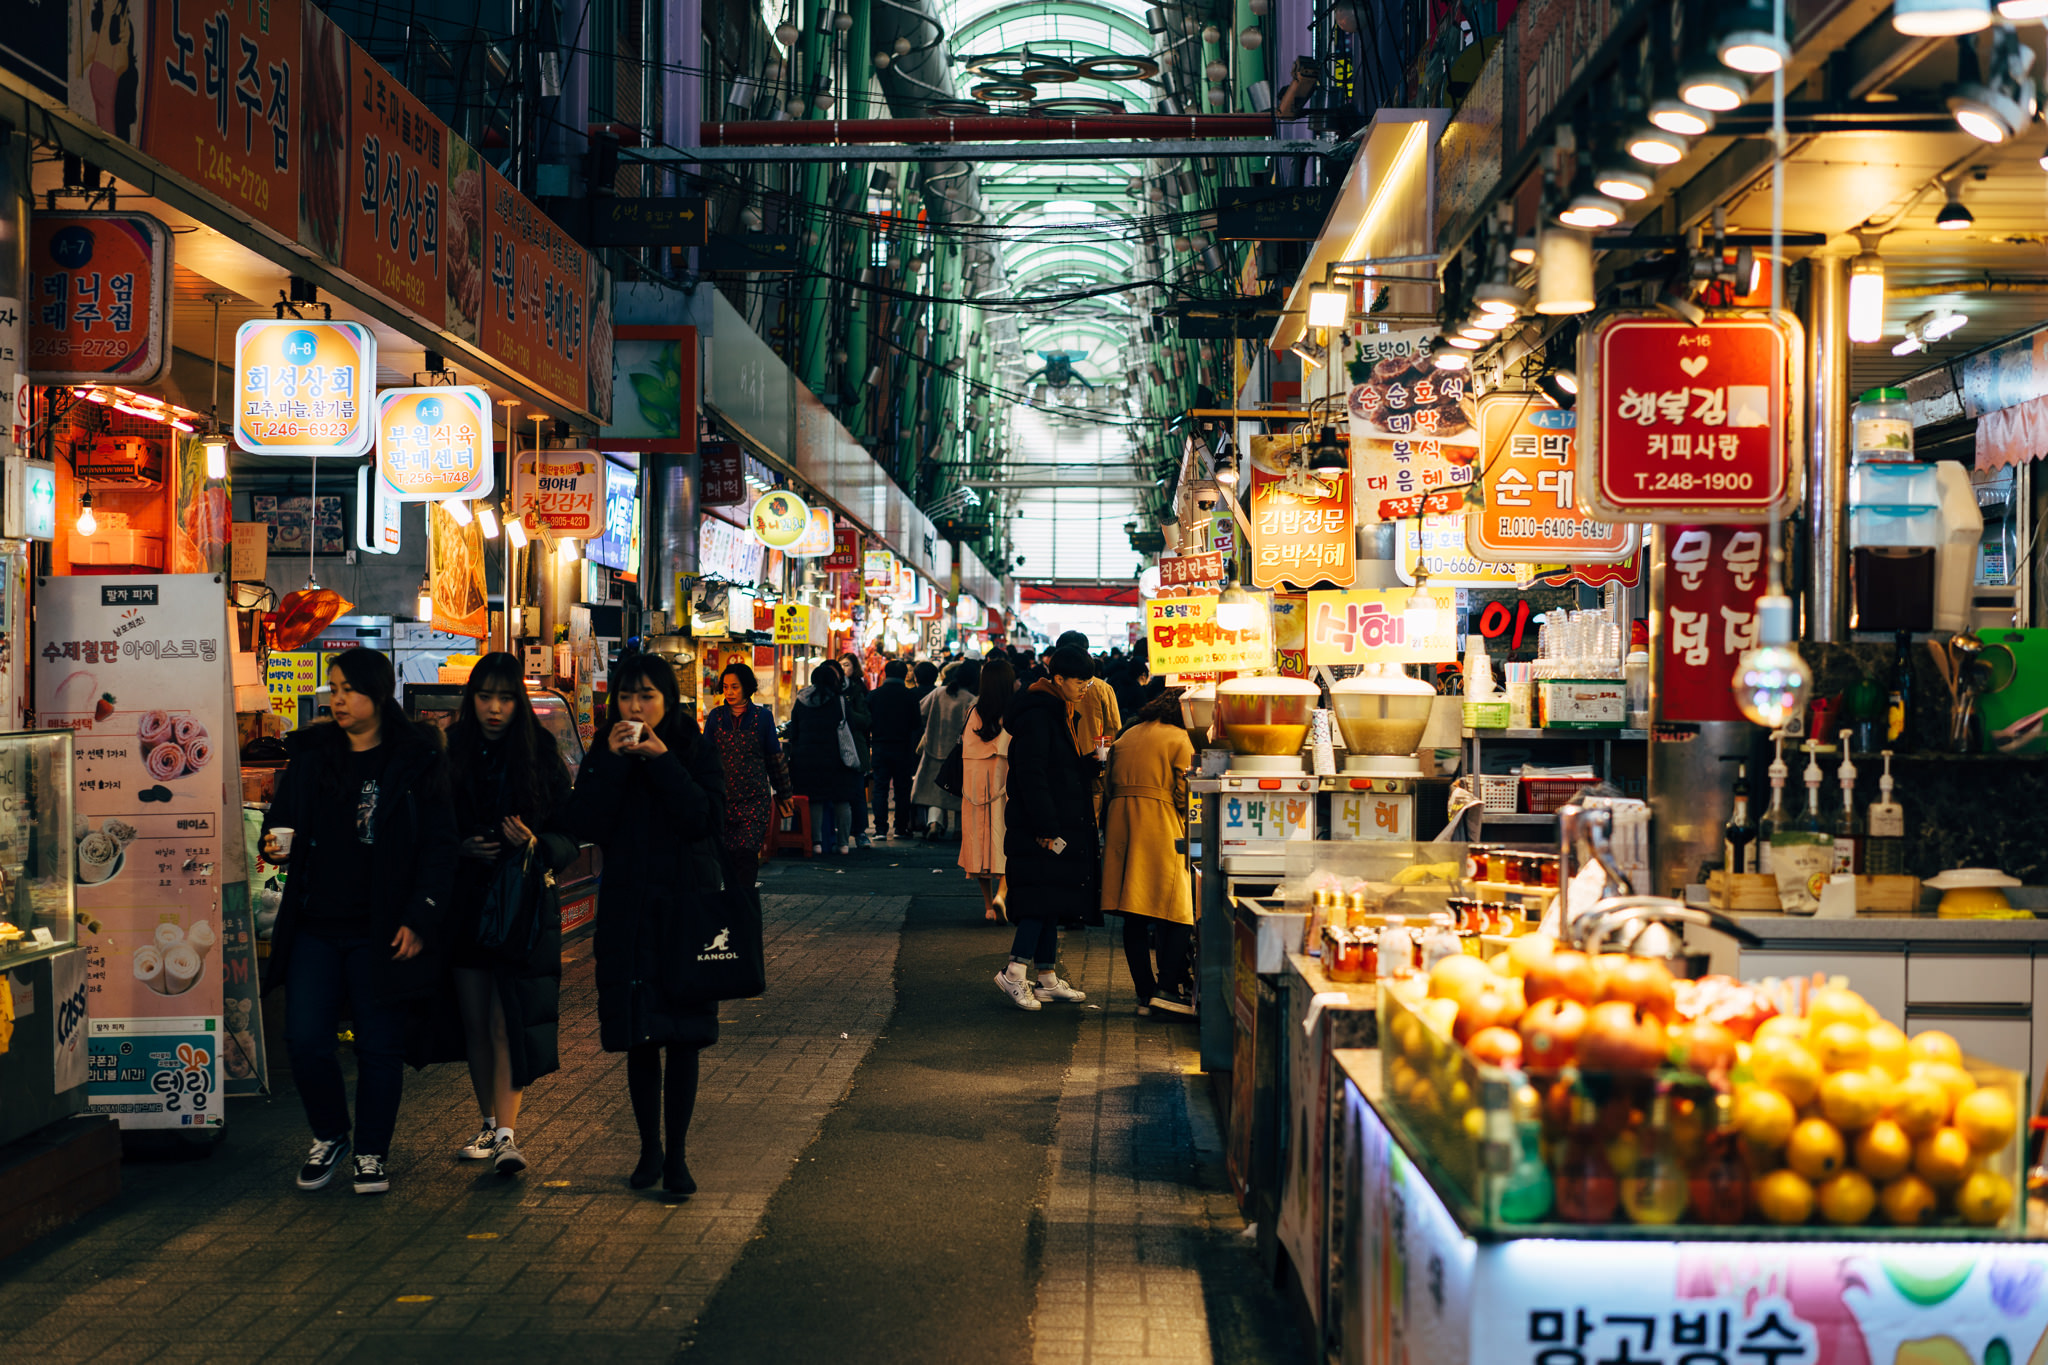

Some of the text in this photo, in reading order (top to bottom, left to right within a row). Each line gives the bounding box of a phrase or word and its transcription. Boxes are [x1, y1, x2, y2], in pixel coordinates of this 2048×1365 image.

[165, 0, 290, 174] 노래주점
[195, 136, 269, 211] T.245-2729
[361, 132, 439, 281] 회성상회
[612, 204, 640, 223] 6번
[58, 240, 87, 255] A-7
[377, 254, 425, 307] T.246-6923
[492, 231, 582, 371] 부원 식육 판매센터
[288, 342, 312, 356] A-8
[1361, 339, 1411, 363] 토박이
[1677, 334, 1712, 347] A-16
[246, 365, 355, 399] 회성상회
[421, 406, 440, 417] A-9
[1539, 413, 1577, 427] A-17
[252, 421, 349, 438] T.246-6923
[388, 424, 476, 448] 부원식육
[388, 447, 474, 471] 판매센터
[1512, 435, 1577, 466] 토박
[1647, 434, 1741, 461] 커피사랑
[396, 471, 470, 485] T.256-1748
[1495, 468, 1576, 510] 순대
[1633, 473, 1754, 491] T.248-1900
[1387, 495, 1449, 514] 전문점
[1257, 509, 1345, 537] 김밥전문
[1499, 518, 1615, 541] H.010-6406-6497
[1408, 531, 1434, 550] 김밥
[1257, 543, 1347, 568] 호박식혜
[106, 589, 155, 602] 팔자 피자
[113, 616, 146, 637] 남포최초!
[1315, 603, 1406, 654] 식혜
[42, 638, 217, 663] 수제철판 아이스크림
[88, 749, 105, 760] 선택
[107, 749, 127, 759] 1가지
[79, 781, 97, 791] 선택
[176, 819, 209, 831] 베이스
[1226, 797, 1307, 837] 호박식혜
[1342, 799, 1399, 837] 식혜
[697, 952, 739, 961] KANGOL
[112, 1022, 126, 1030] 피자
[120, 1068, 146, 1081] 시간!
[153, 1069, 210, 1111] 텔링
[1528, 1309, 1808, 1365] 망고빙수
